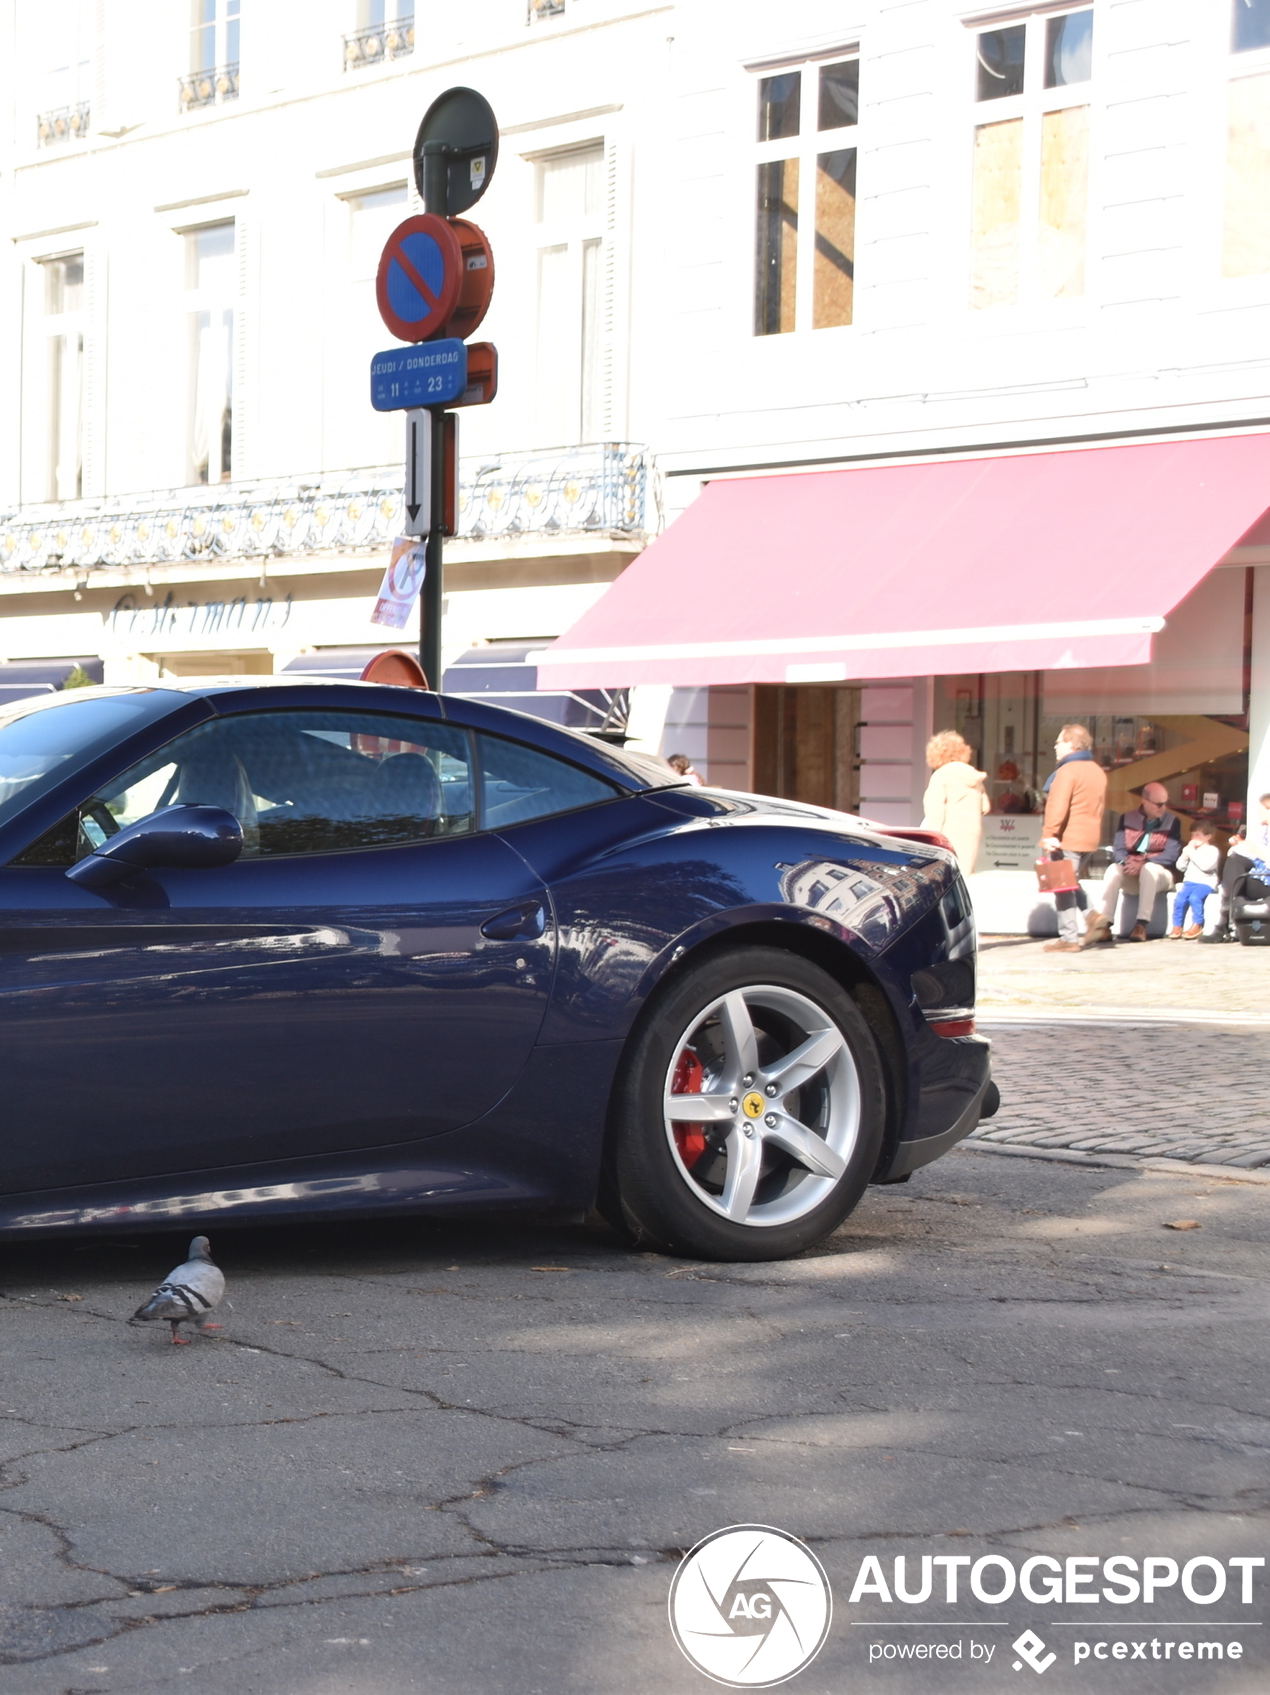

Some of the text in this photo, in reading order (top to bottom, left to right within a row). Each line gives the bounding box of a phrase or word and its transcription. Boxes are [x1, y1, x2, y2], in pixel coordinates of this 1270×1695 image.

[372, 361, 396, 376] JEUDI
[407, 351, 459, 370] DONDERDAG
[391, 382, 399, 398] 11
[428, 375, 443, 393] 23
